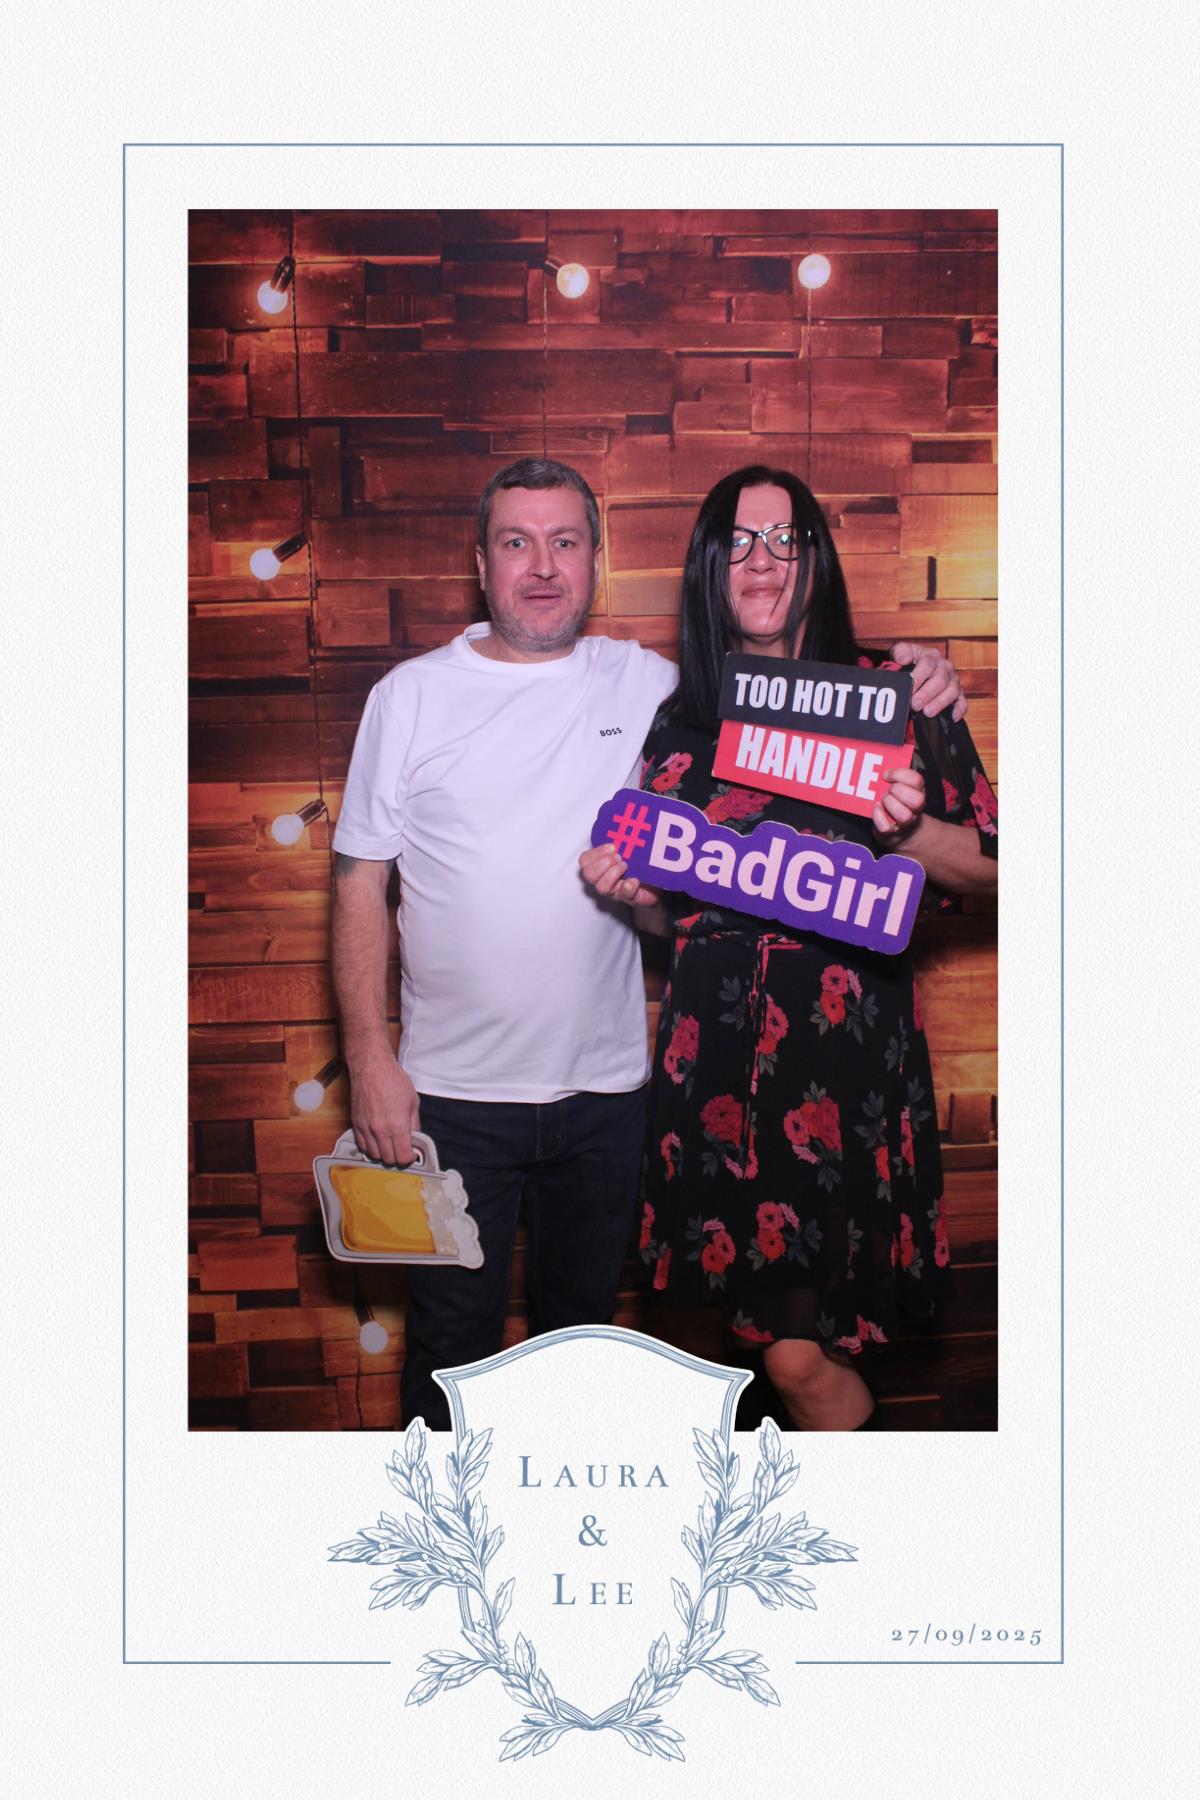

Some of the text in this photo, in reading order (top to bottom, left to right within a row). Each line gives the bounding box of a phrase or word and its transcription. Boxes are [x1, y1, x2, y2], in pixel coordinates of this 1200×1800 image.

[735, 673, 897, 724] TOO HOT TO
[600, 727, 622, 737] BOSS
[735, 724, 884, 801] HANDLE
[607, 802, 914, 937] #BadGirl
